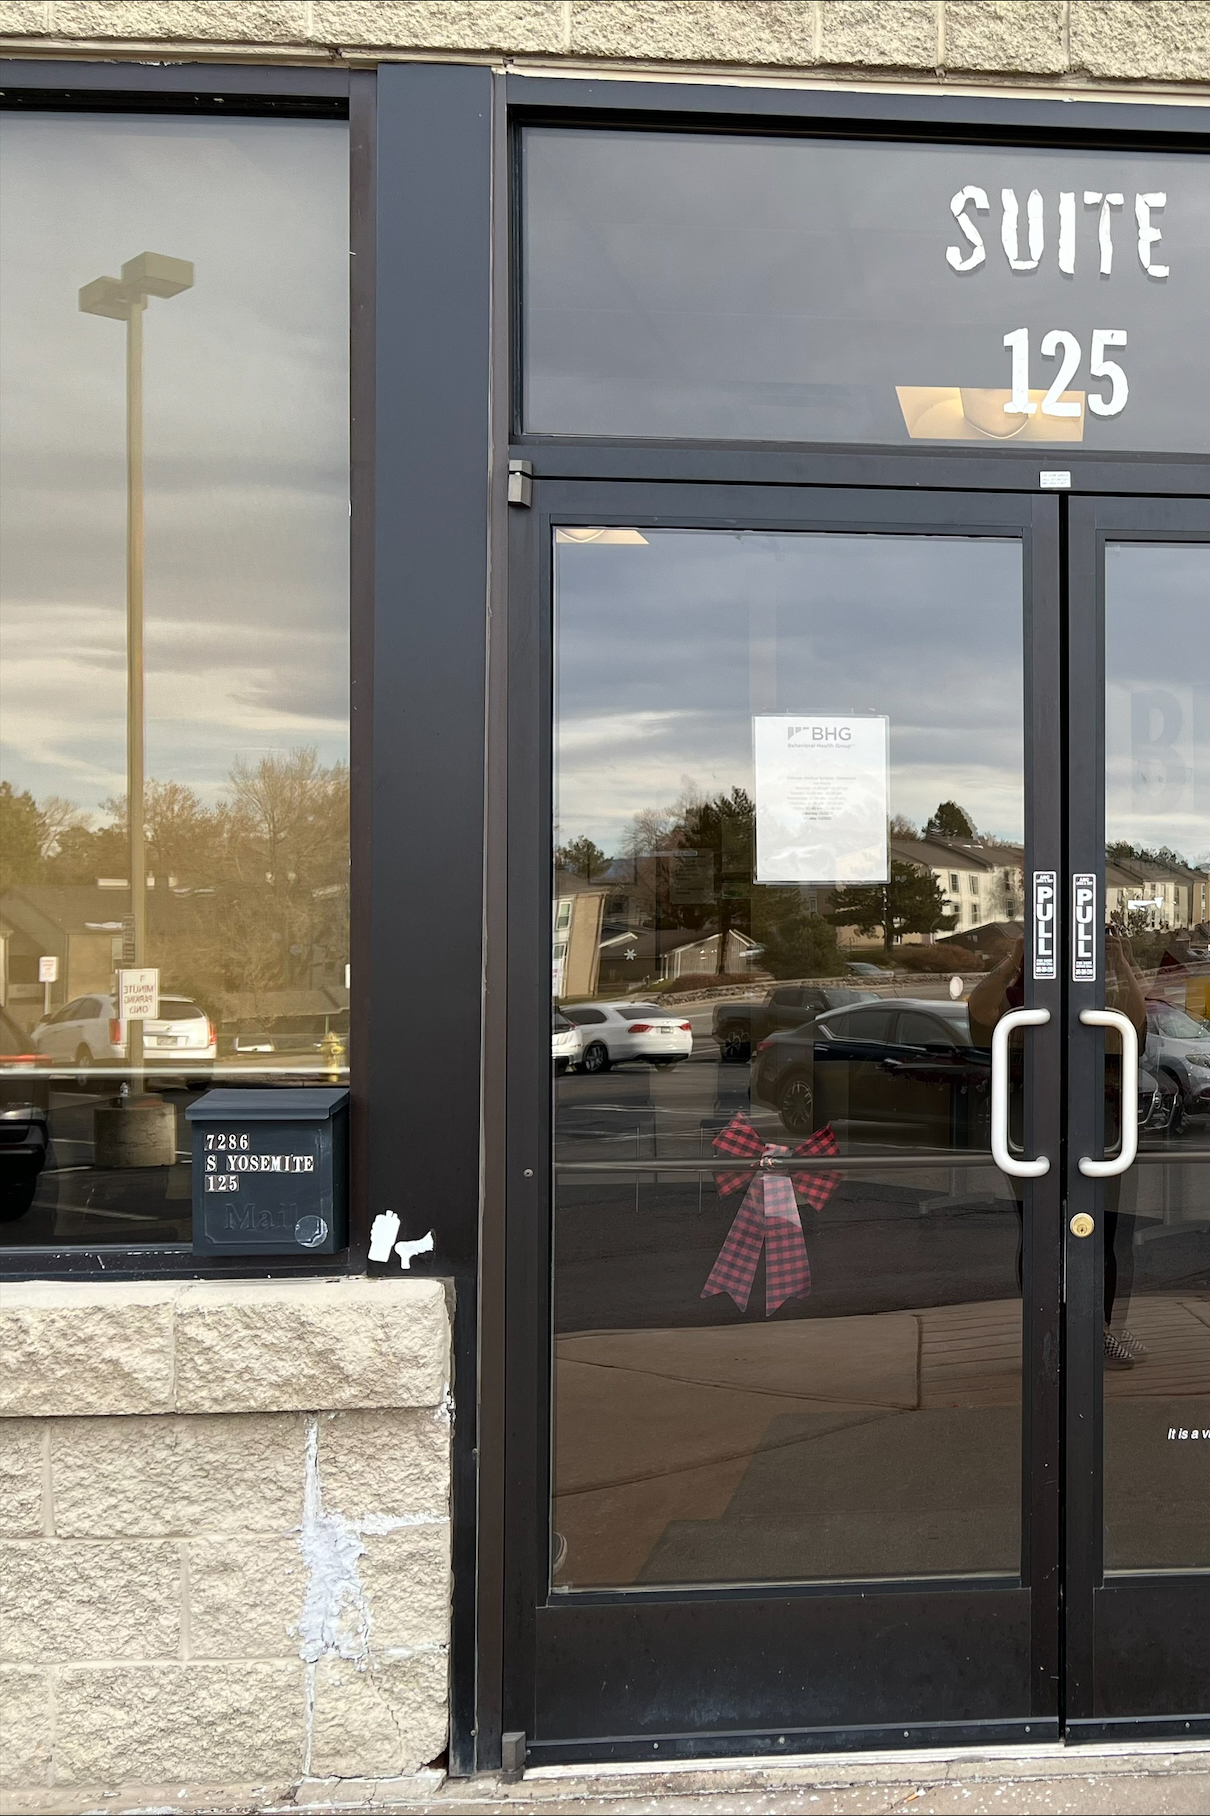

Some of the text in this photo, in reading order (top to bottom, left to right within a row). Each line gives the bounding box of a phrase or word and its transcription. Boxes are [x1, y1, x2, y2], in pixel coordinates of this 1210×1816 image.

[946, 185, 1169, 277] SUITE
[1003, 328, 1128, 416] 125
[812, 727, 851, 741] BHG
[1036, 886, 1053, 955] PULL
[1076, 889, 1093, 957] PULL
[206, 1134, 249, 1150] 7286
[206, 1155, 314, 1171] S YOSEMITE
[207, 1175, 238, 1191] 125
[224, 1203, 299, 1231] Mail
[1167, 1428, 1176, 1440] It
[1178, 1427, 1188, 1440] is
[1191, 1429, 1199, 1439] a
